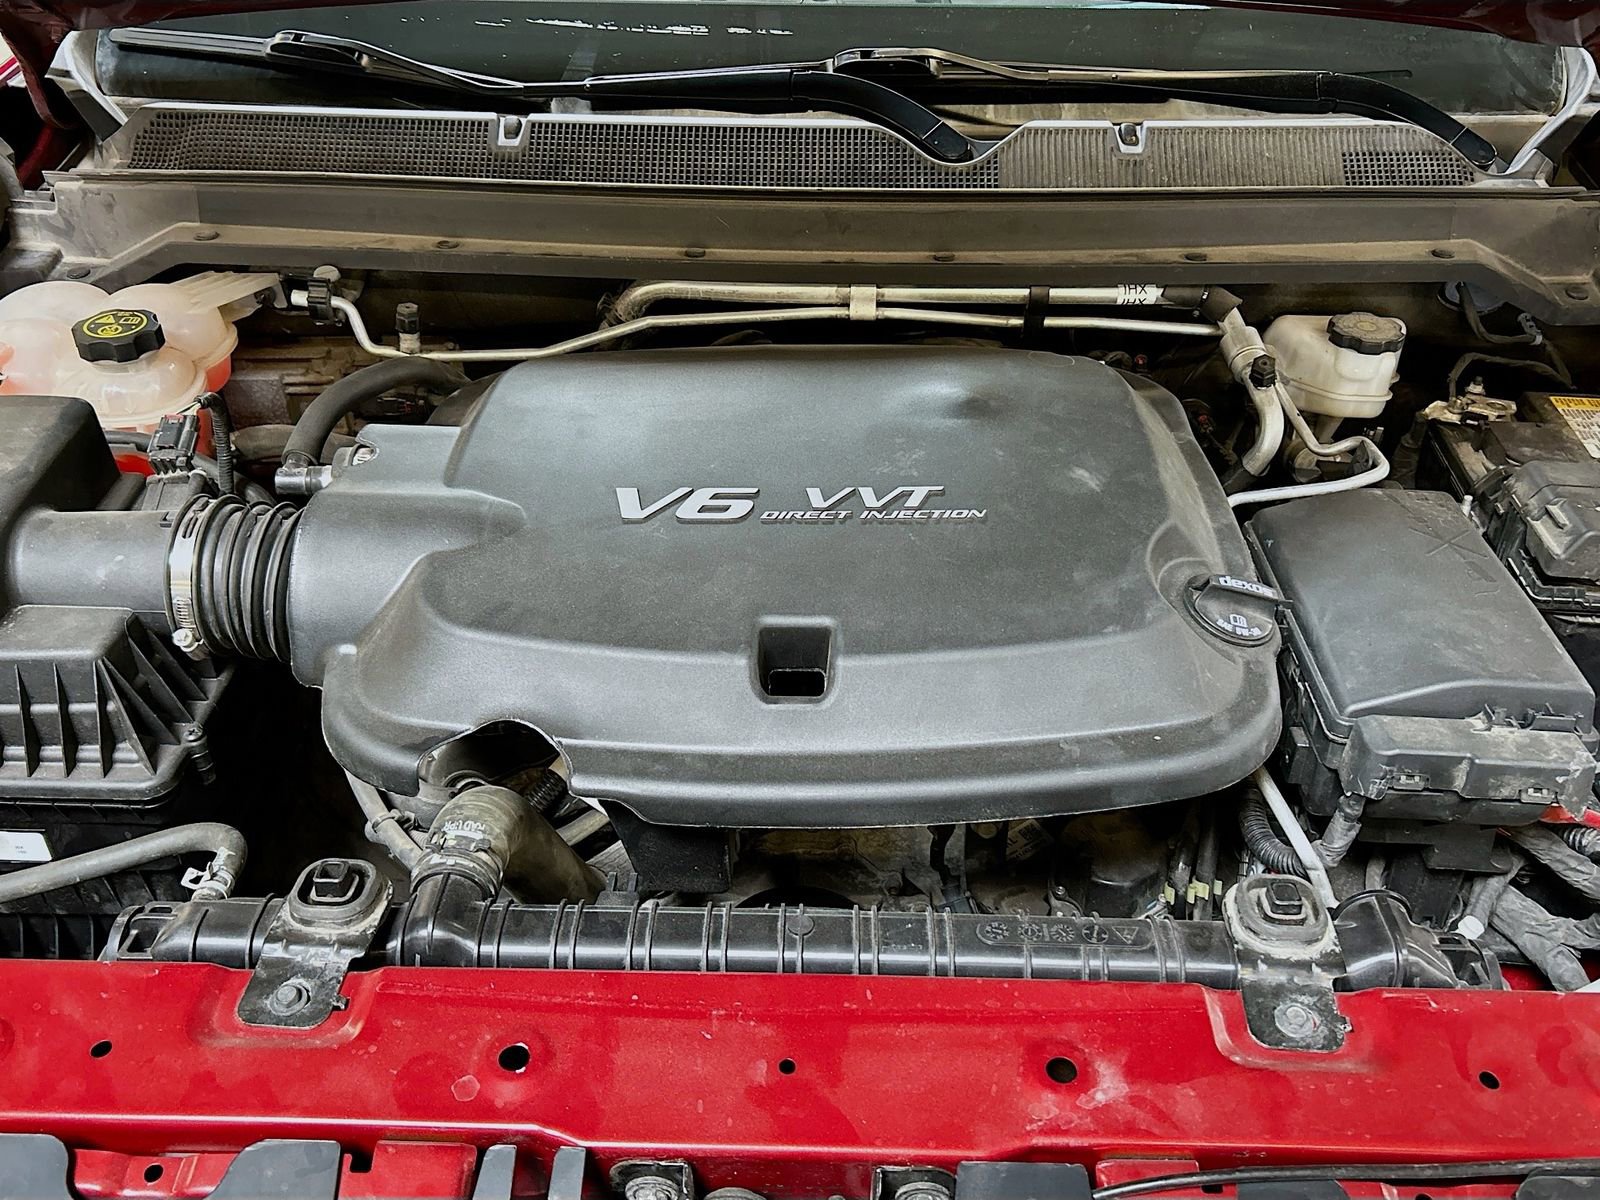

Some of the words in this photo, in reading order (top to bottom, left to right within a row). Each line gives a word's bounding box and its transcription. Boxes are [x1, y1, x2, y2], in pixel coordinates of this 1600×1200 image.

[615, 486, 760, 520] V6
[805, 485, 945, 508] VVT
[760, 510, 852, 520] DIRECT
[860, 509, 988, 520] INJECTION
[1218, 575, 1274, 597] dexos
